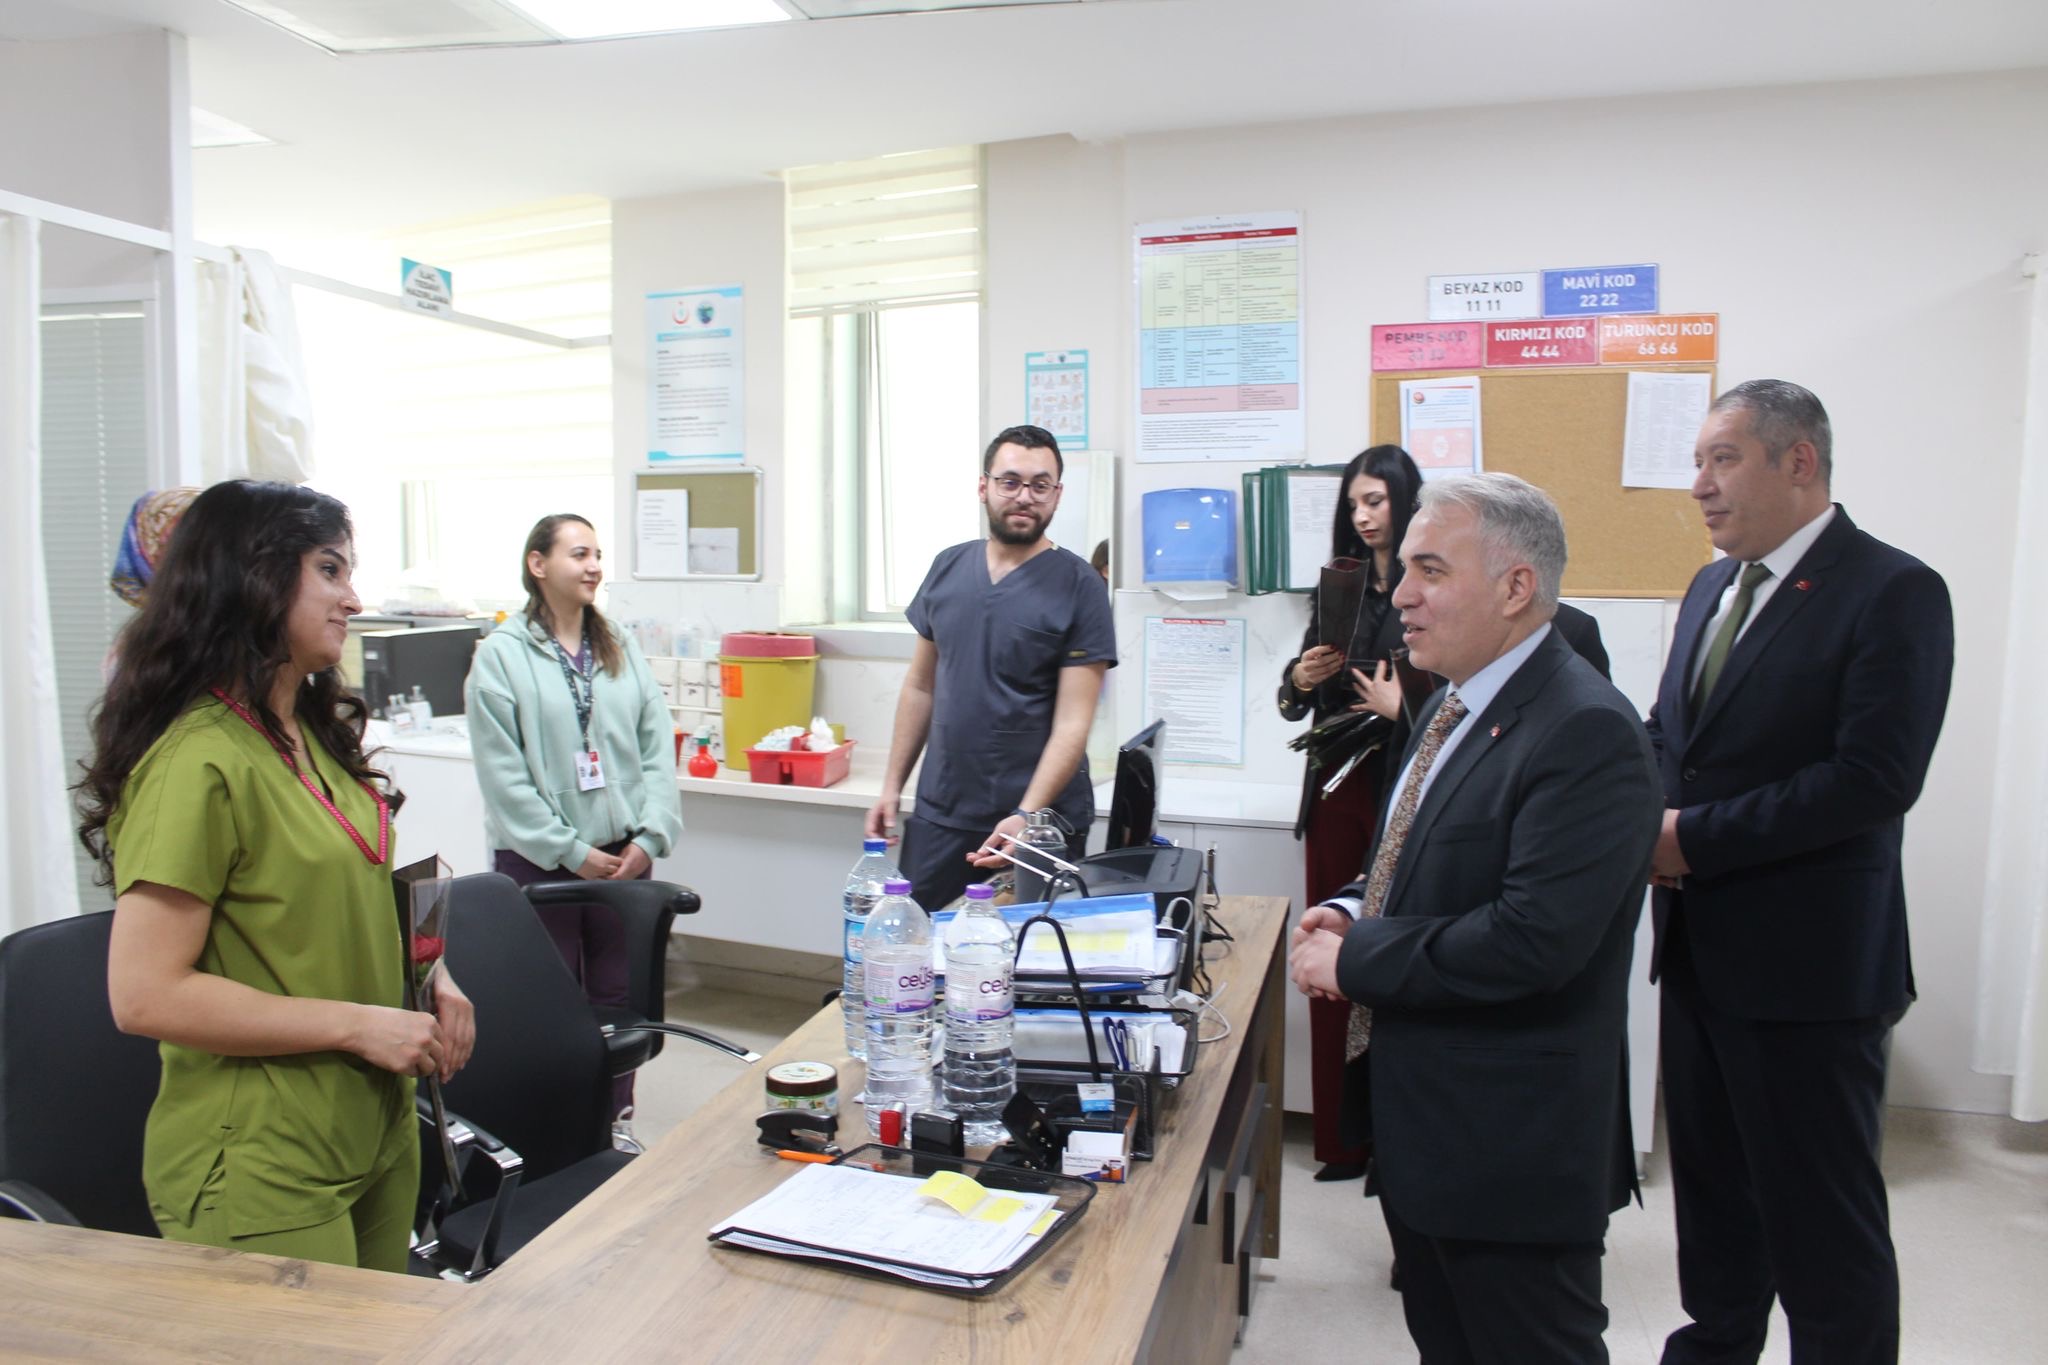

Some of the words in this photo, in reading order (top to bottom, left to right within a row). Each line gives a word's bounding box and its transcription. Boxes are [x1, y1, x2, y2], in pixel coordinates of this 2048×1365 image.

[1444, 282, 1490, 295] BEYAZ
[1494, 280, 1524, 293] KOD
[1563, 274, 1600, 290] MAVİ
[1604, 274, 1636, 288] KOD
[1466, 300, 1481, 311] 11
[1487, 299, 1501, 310] 11
[1580, 295, 1598, 307] 22
[1601, 293, 1619, 306] 22
[1495, 327, 1551, 341] KIRMIZI
[1555, 326, 1586, 340] KOD
[1604, 323, 1678, 337] TURUNCU
[1681, 322, 1714, 336] KOD
[1385, 330, 1433, 344] PEMBE
[1521, 346, 1538, 358] 44
[1541, 345, 1560, 357] 44
[1638, 342, 1657, 355] 66
[1660, 341, 1678, 354] 66
